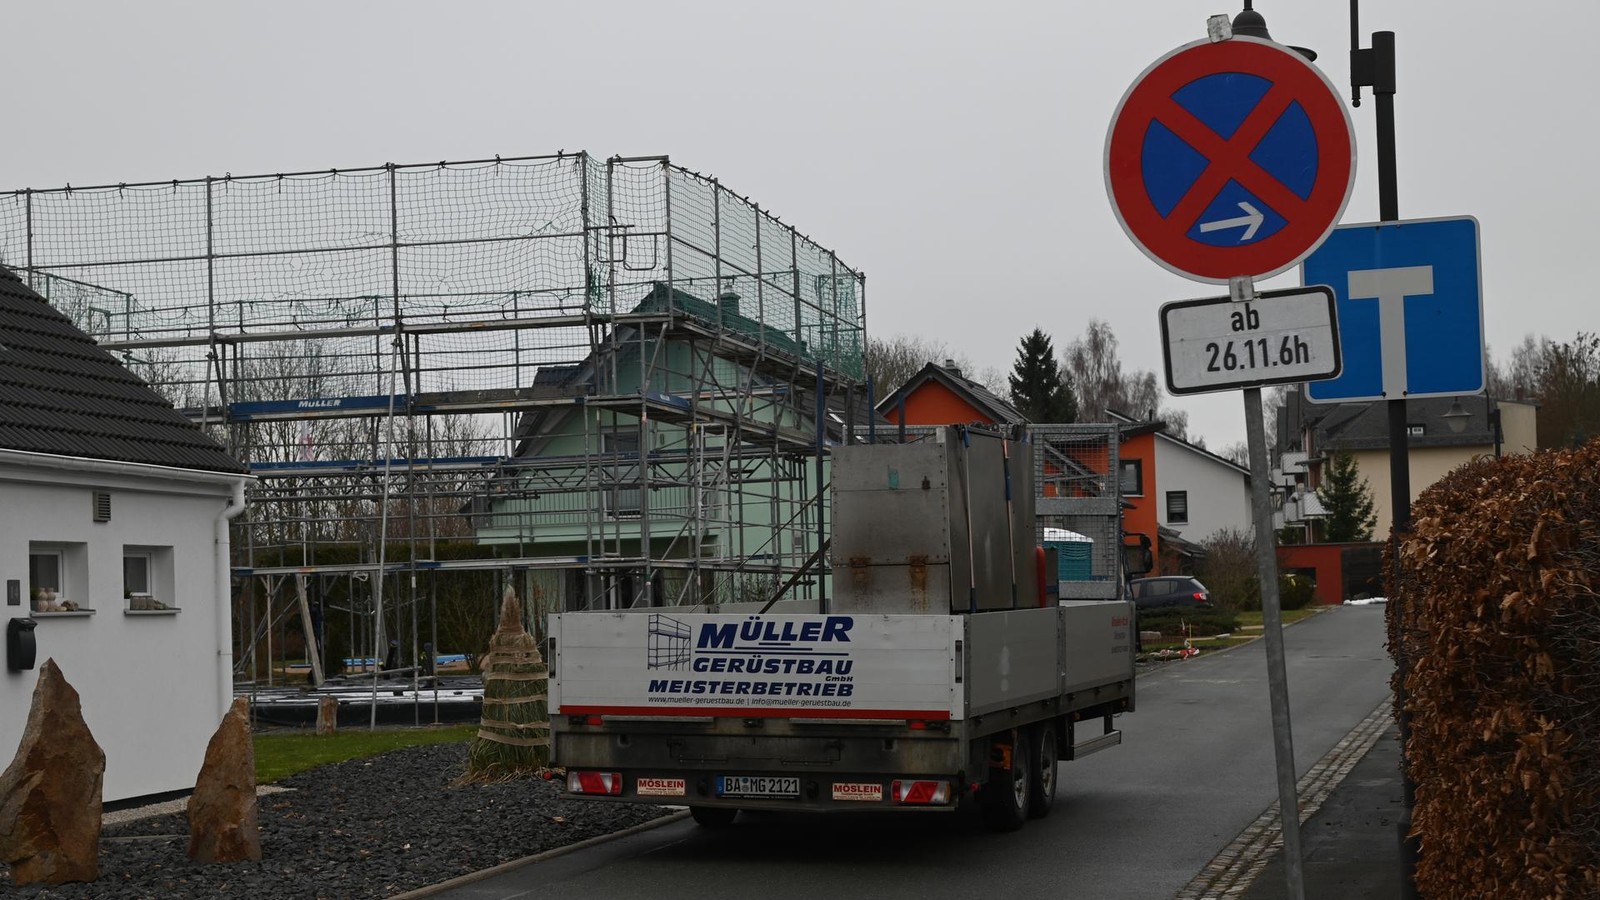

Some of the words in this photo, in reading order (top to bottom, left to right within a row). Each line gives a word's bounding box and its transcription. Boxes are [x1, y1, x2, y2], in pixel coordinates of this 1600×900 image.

[1231, 302, 1260, 332] ab
[1205, 334, 1310, 372] 26.11.6h
[697, 616, 853, 649] MÜLLER
[693, 655, 853, 675] GERÜSTBAU
[648, 679, 853, 697] MEISTERBETRIEB
[648, 697, 745, 705] www.mueller-geruestbau.de
[751, 698, 852, 708] info@mueller-geruestbau.de
[725, 778, 740, 792] BA
[750, 778, 766, 793] MG
[768, 779, 799, 794] 2121
